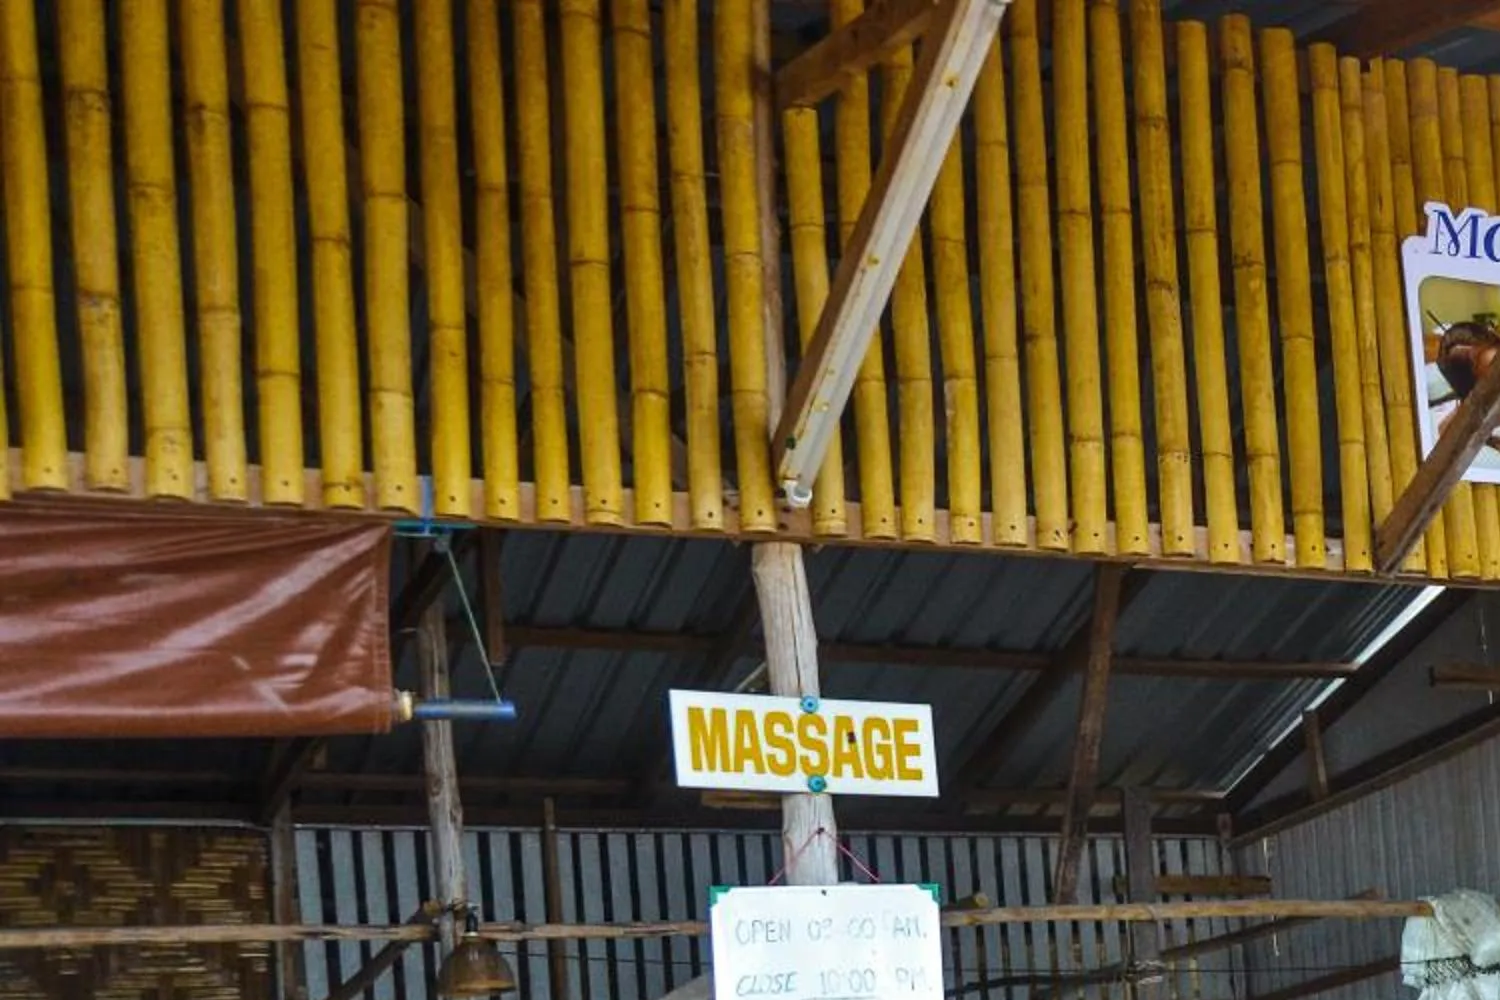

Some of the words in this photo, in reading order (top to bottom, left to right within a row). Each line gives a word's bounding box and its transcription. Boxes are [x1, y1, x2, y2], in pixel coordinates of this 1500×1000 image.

[687, 706, 924, 782] MASSAGE
[734, 916, 792, 946] OPEN
[735, 969, 798, 999] CLOSE
